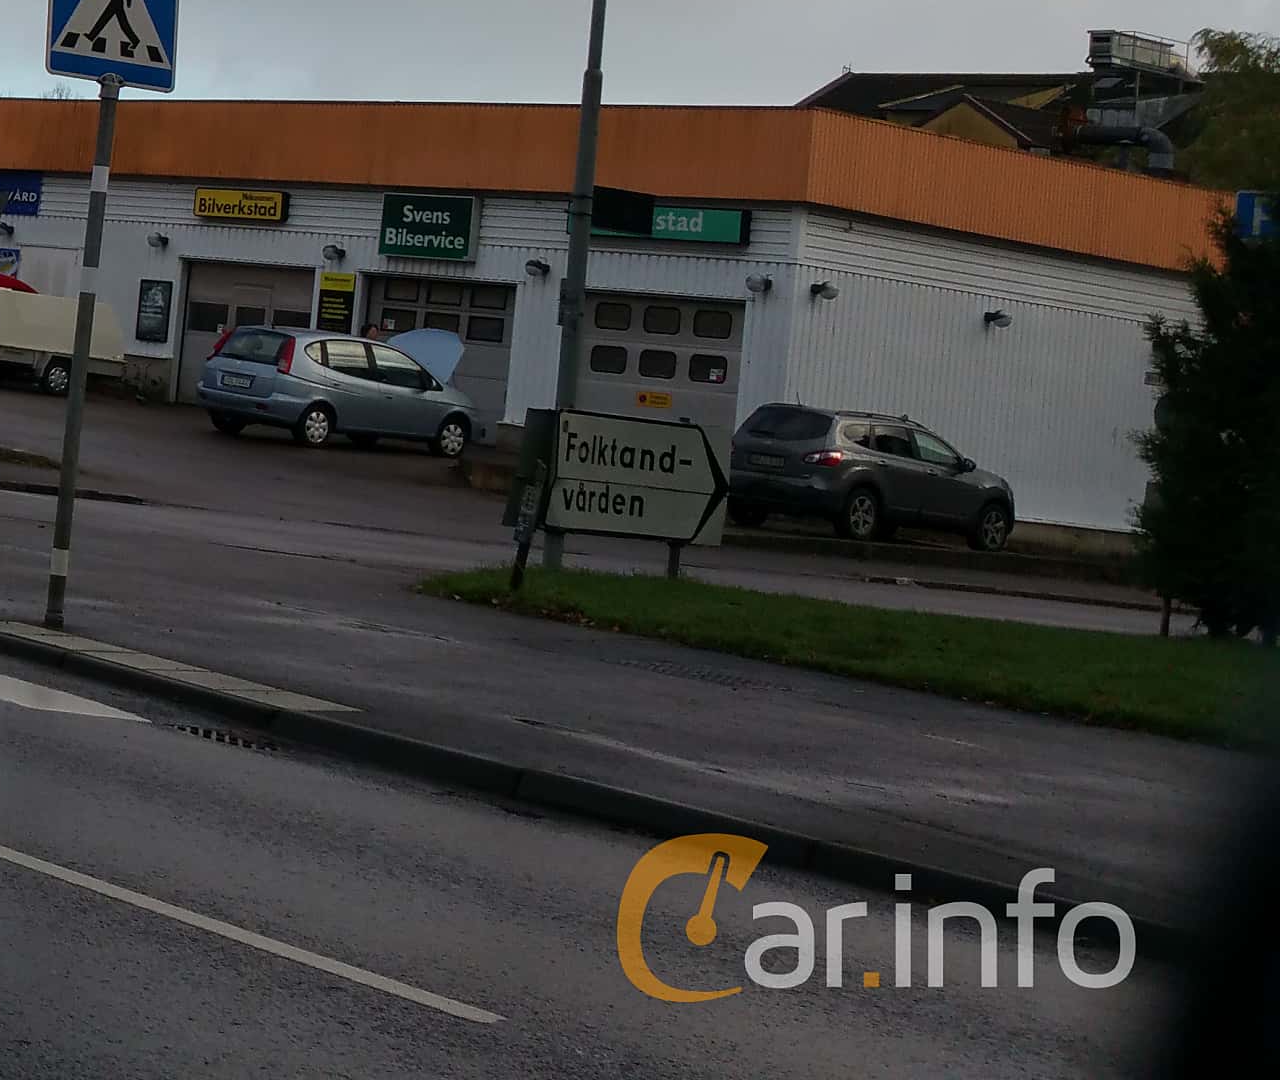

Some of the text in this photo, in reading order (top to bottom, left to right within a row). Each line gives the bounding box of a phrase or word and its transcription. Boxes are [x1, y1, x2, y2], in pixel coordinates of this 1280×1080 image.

[198, 197, 277, 217] Bilverkstad
[402, 204, 451, 224] Svens
[384, 227, 465, 250] Bilservice
[564, 431, 692, 474] Folktand-
[562, 482, 645, 518] vården
